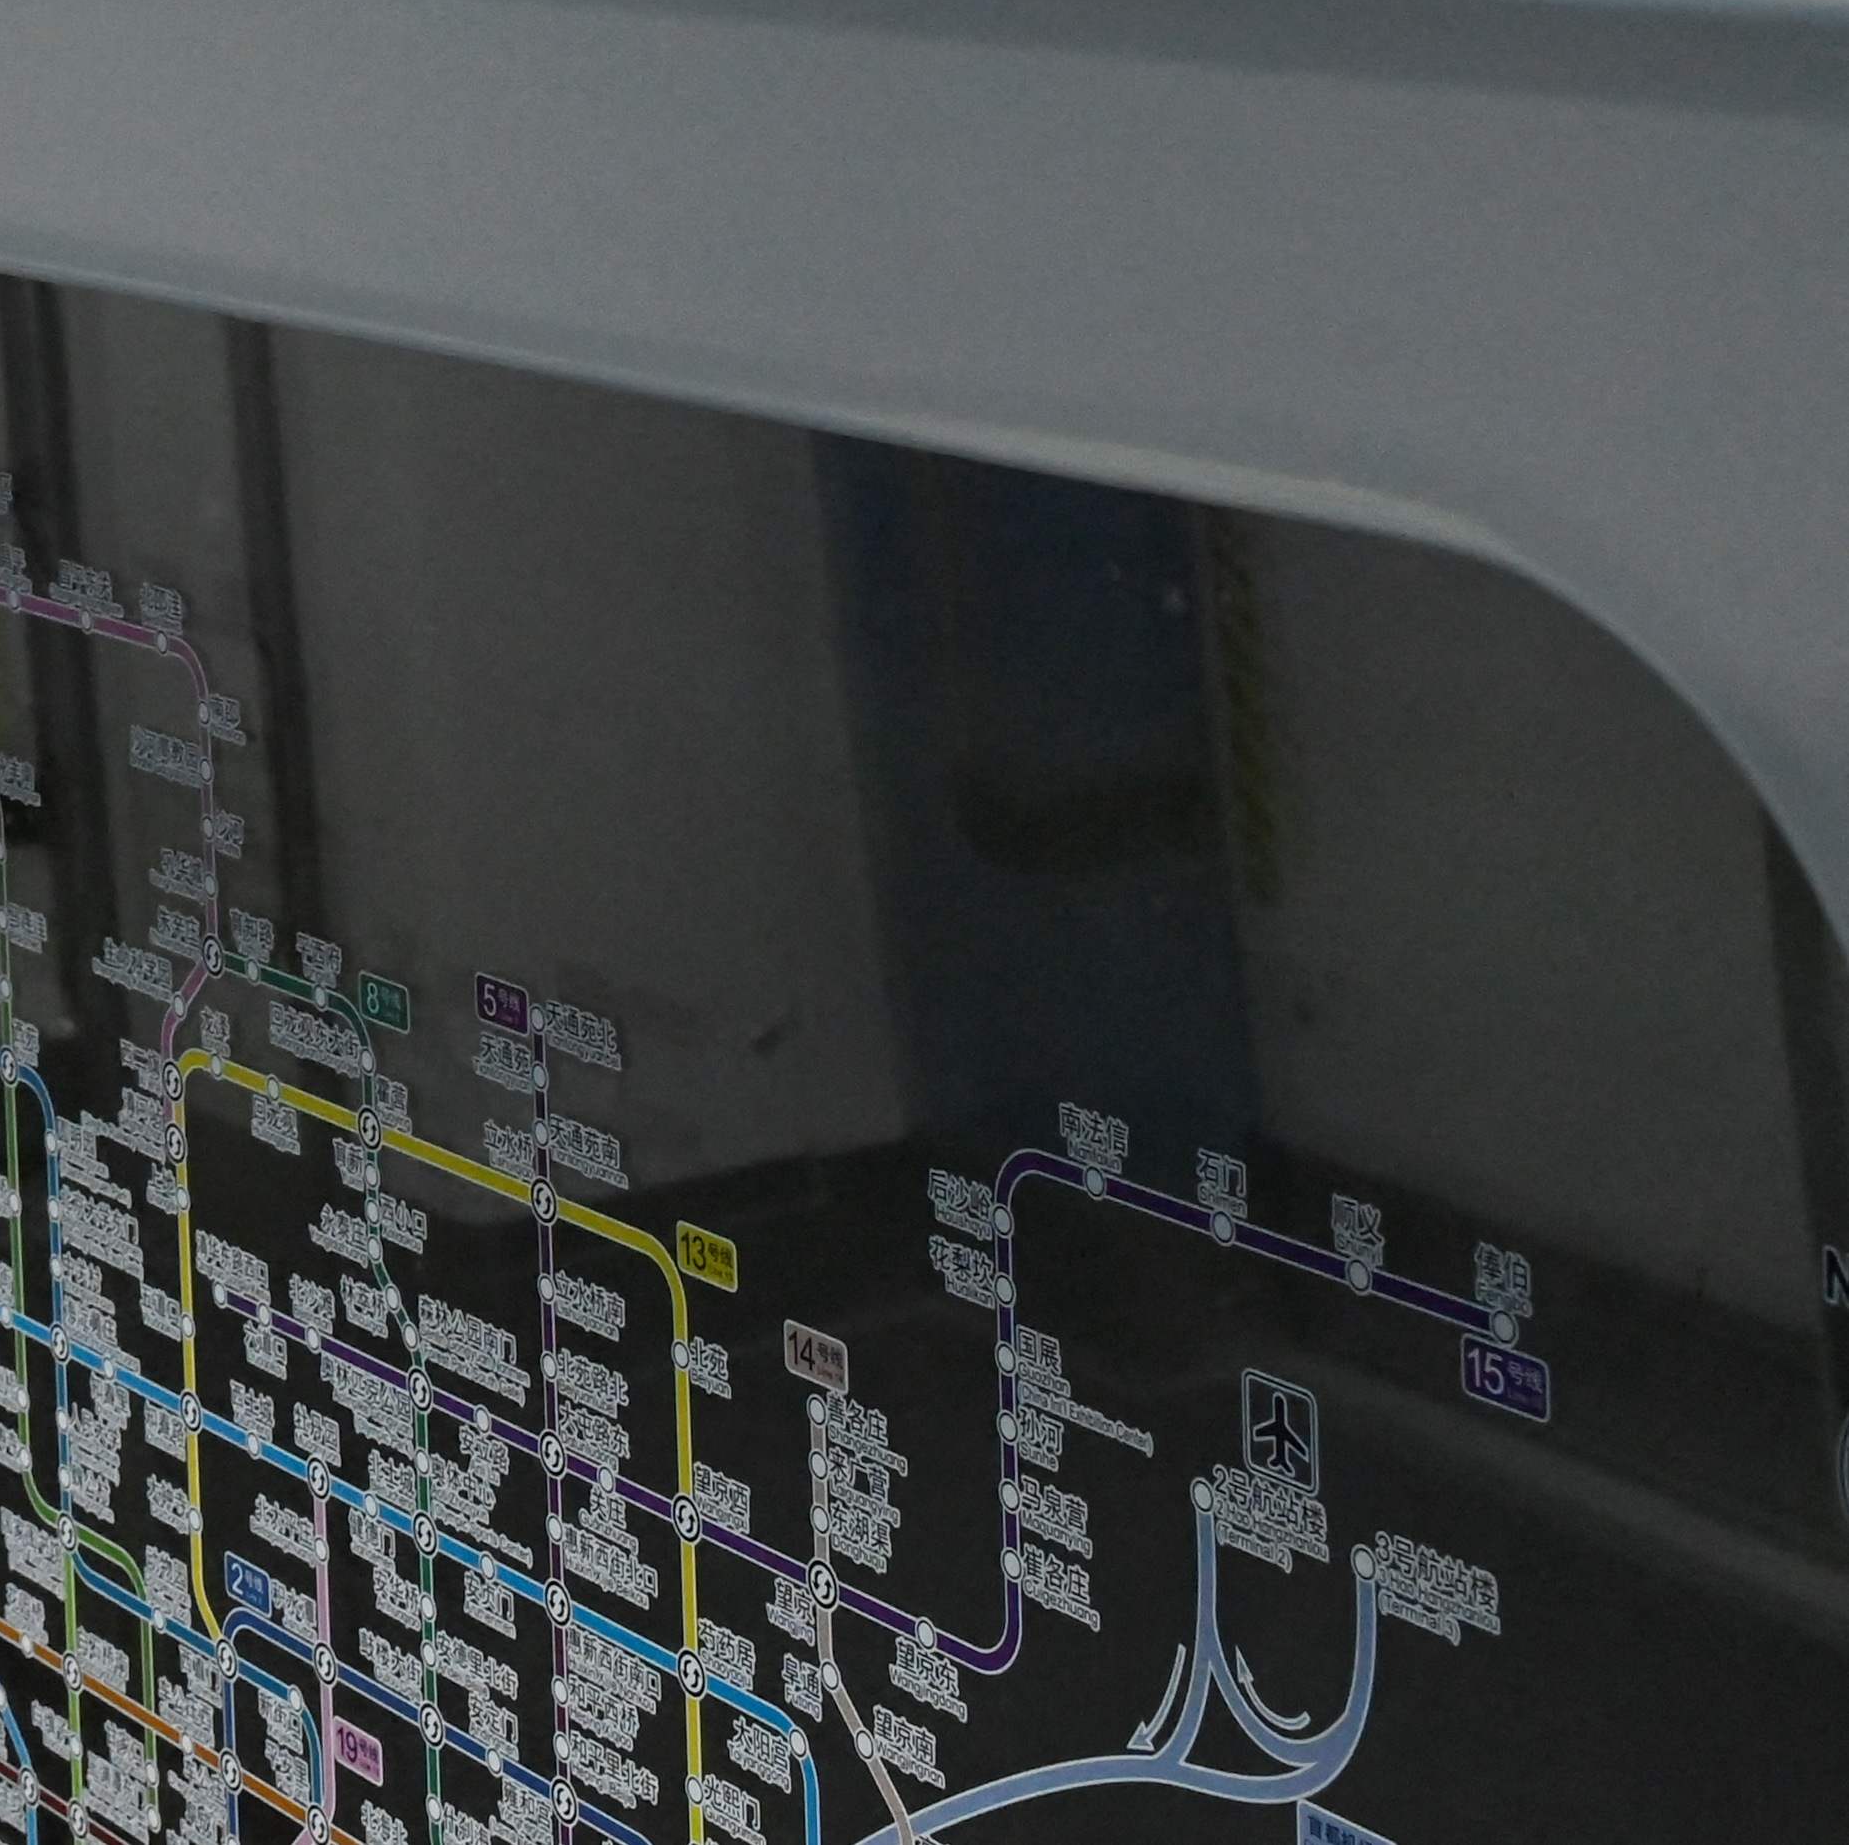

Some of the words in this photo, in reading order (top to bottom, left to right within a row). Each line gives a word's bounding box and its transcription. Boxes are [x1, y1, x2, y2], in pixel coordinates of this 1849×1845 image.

[479, 1032, 531, 1076] 天通苑
[546, 1000, 617, 1053] 天通苑北
[483, 1119, 535, 1163] 立水桥
[550, 1114, 621, 1168] 天通苑南
[1059, 1102, 1129, 1157] 南法信
[928, 1167, 993, 1220] 后沙峪
[1197, 1148, 1247, 1196] 石门
[1331, 1193, 1384, 1245] 顺义
[681, 1232, 733, 1271] 13号线
[928, 1235, 995, 1284] 花梨坎
[555, 1270, 625, 1328] 立水桥南
[557, 1347, 629, 1406] 北苑路北
[689, 1336, 729, 1381] 北苑
[788, 1330, 843, 1370] 14号线
[1017, 1324, 1062, 1374] 国展
[1466, 1346, 1544, 1396] 15号线
[559, 1400, 630, 1459] 大屯路东
[826, 1390, 888, 1446] 善各庄
[1019, 1406, 1064, 1454] 孙河
[693, 1461, 750, 1520] 望京西
[829, 1447, 889, 1502] 来广营
[589, 1486, 627, 1529] 关庄
[830, 1501, 893, 1558] 东湖渠
[1021, 1476, 1088, 1534] 马泉营
[1212, 1464, 1327, 1543] 2号航站楼
[563, 1523, 658, 1598] 惠新西街北口
[1021, 1509, 1092, 1559] Maquanying
[1216, 1521, 1275, 1565] (Terminal
[1276, 1545, 1292, 1574] 2)
[1024, 1543, 1091, 1604] 崔各庄
[1375, 1531, 1498, 1615] 3号航站楼
[774, 1578, 815, 1625] 望京
[1023, 1579, 1101, 1632] Cuigezhuang
[1378, 1589, 1442, 1635] (Terminal
[1444, 1614, 1461, 1646] 3)
[568, 1626, 661, 1701] 惠新西街南口
[698, 1618, 756, 1675] 芍药居
[895, 1636, 959, 1697] 望京东
[568, 1674, 640, 1739] 和平西桥
[781, 1653, 823, 1705] 阜通
[889, 1664, 968, 1723] Wangjingdong
[732, 1715, 790, 1775] 太阳宫
[873, 1705, 936, 1767] 望京南
[874, 1737, 946, 1789] Wangjingnan
[570, 1730, 661, 1805] 和平里北街
[703, 1773, 761, 1830] 光熙门
